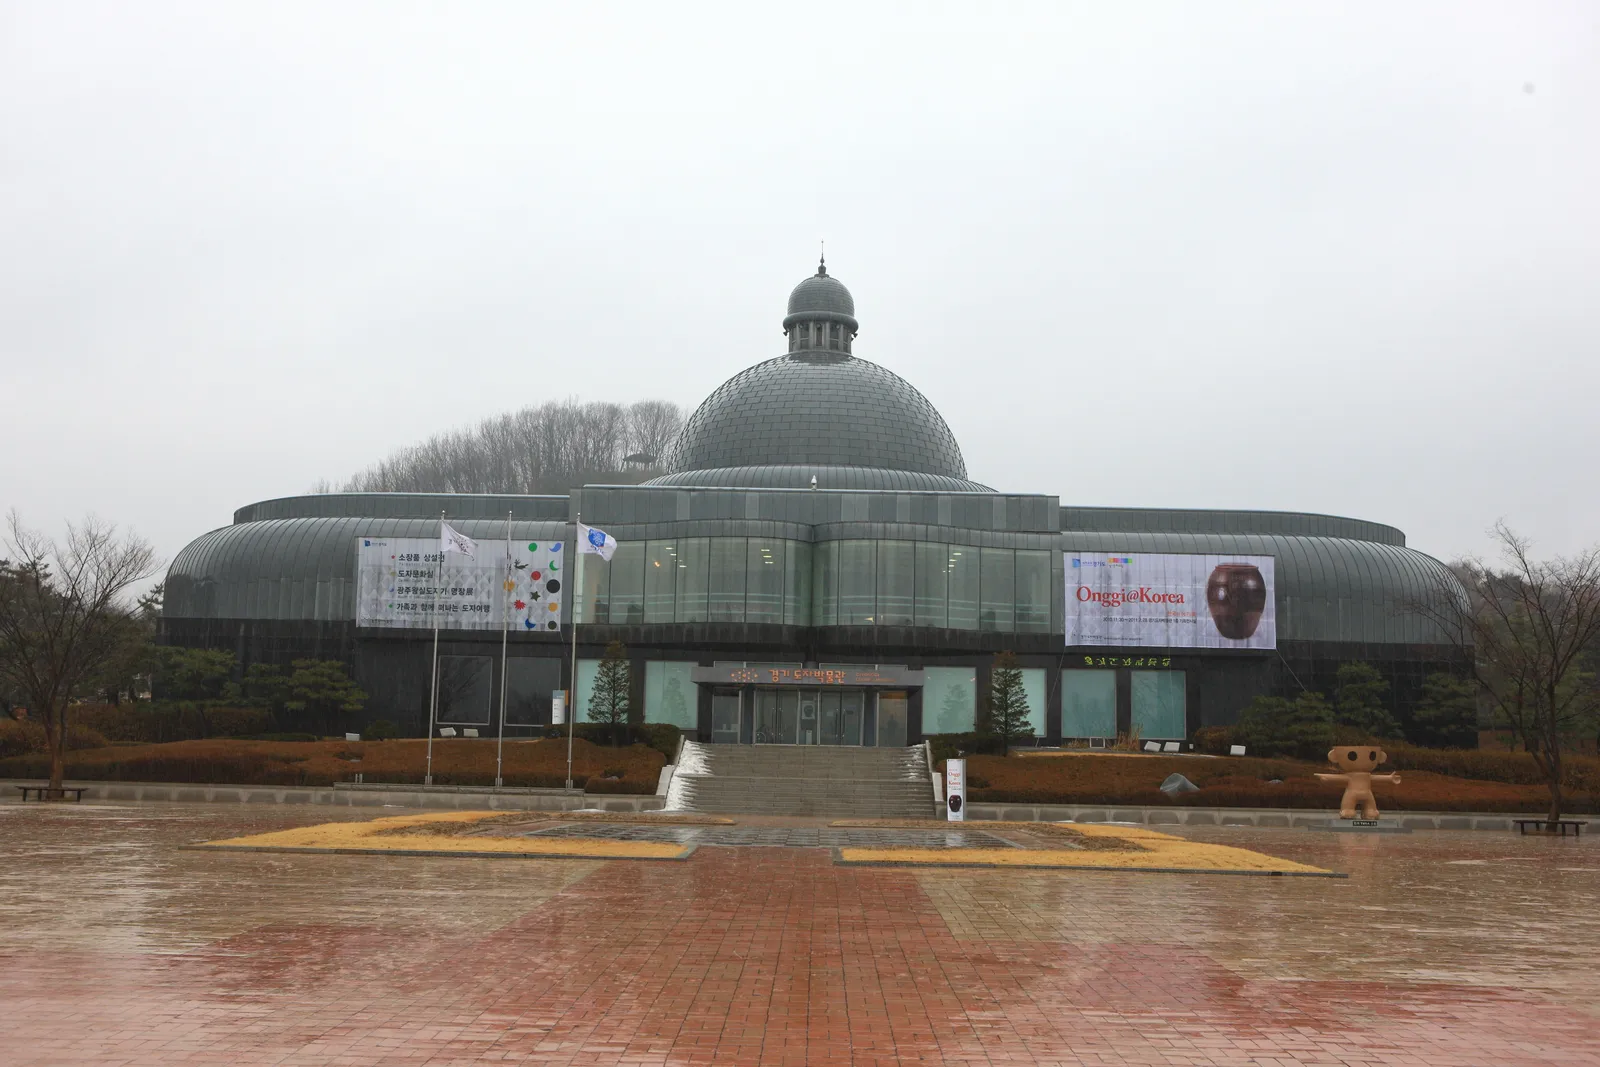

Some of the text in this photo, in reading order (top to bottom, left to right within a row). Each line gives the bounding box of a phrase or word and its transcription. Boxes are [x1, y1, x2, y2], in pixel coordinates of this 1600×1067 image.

[398, 553, 420, 562] 소장품
[398, 569, 434, 578] 도자문화실
[1076, 585, 1185, 608] Onggi@Korea
[396, 602, 418, 612] 가족과
